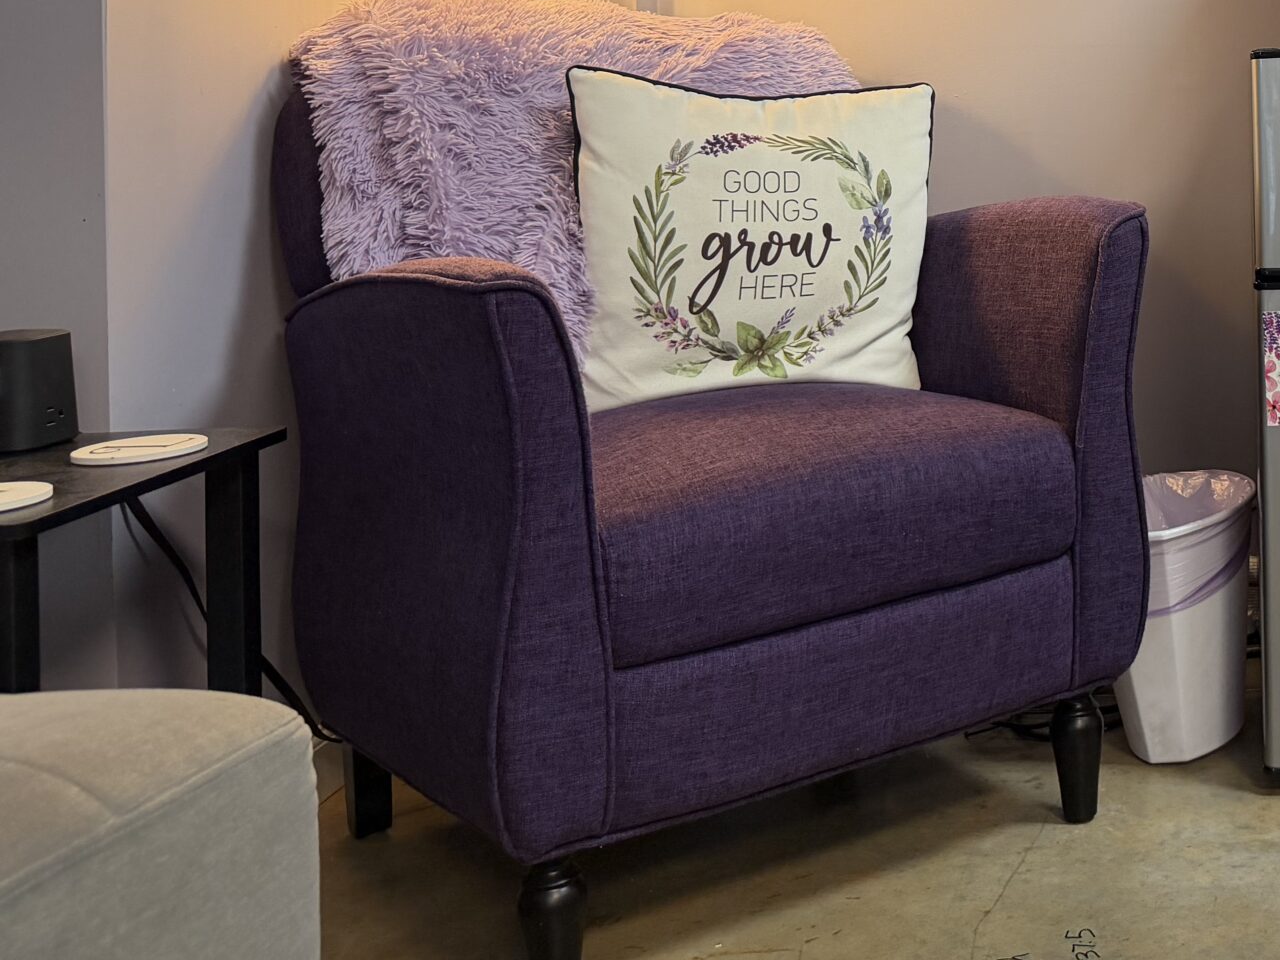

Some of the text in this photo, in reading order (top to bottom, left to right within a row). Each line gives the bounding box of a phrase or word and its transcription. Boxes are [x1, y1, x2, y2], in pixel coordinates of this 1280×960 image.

[723, 170, 801, 194] GOOD
[712, 198, 818, 223] THINGS
[688, 223, 841, 315] grow
[739, 272, 816, 300] HERE
